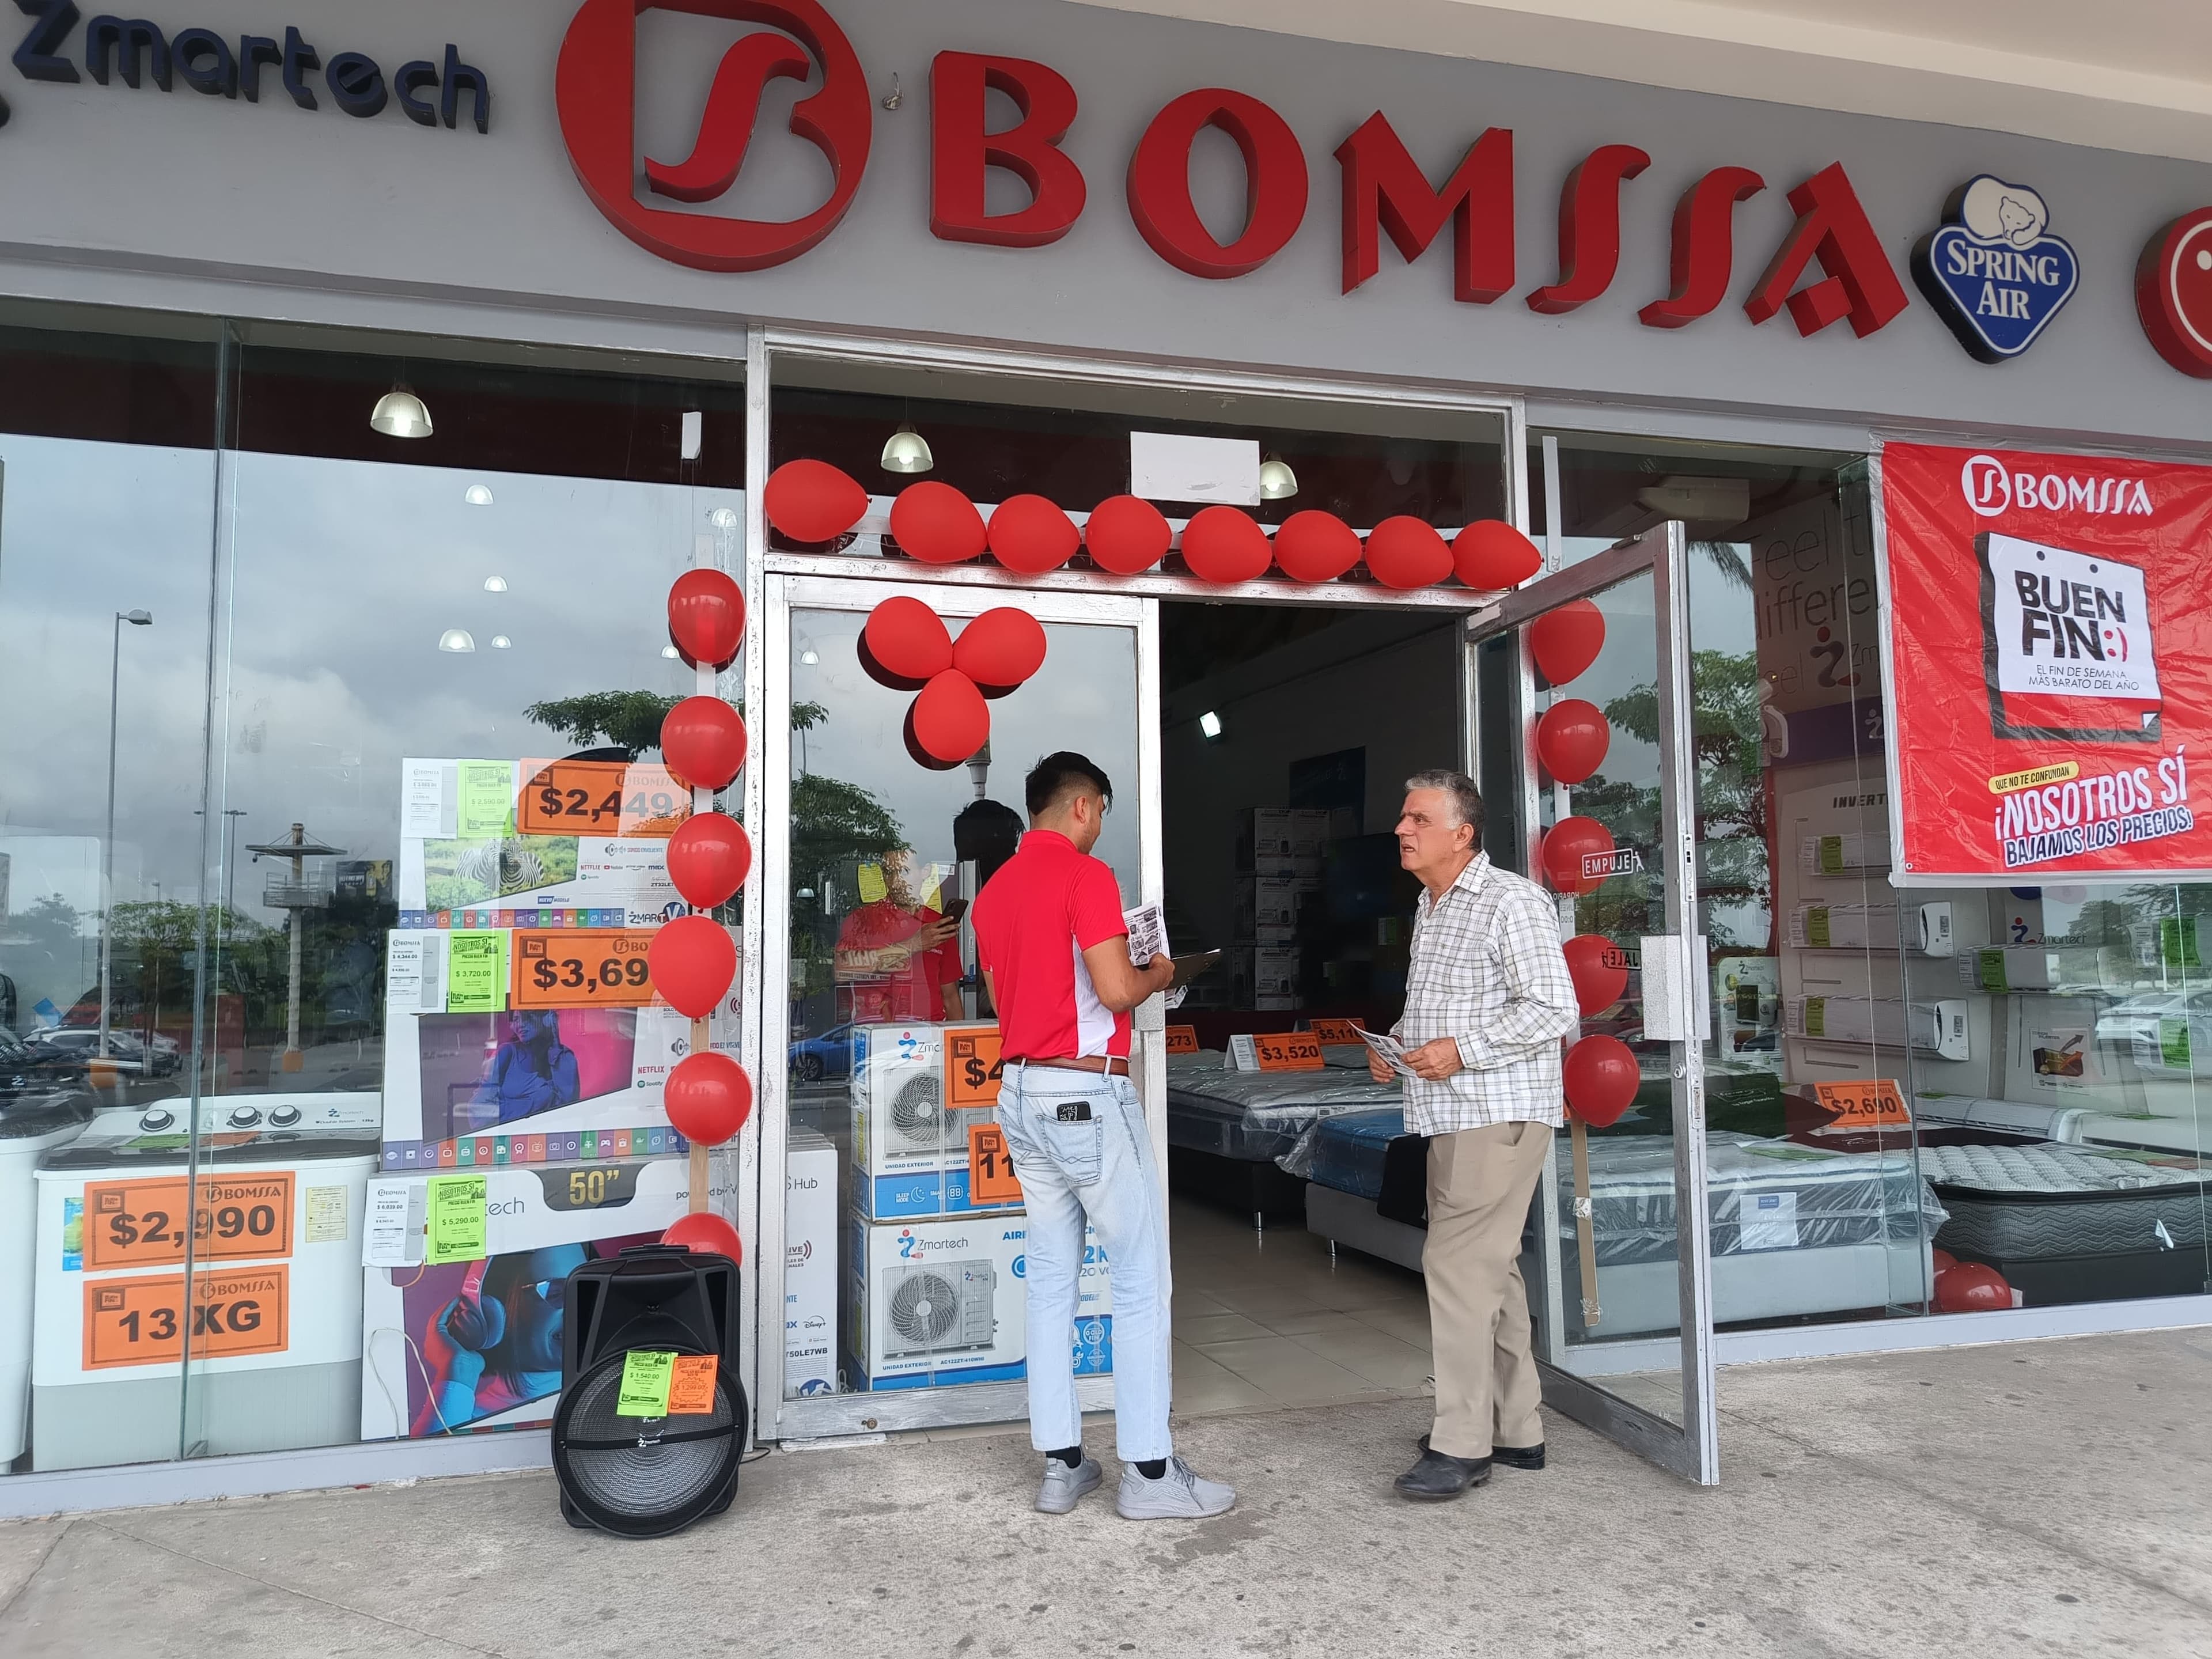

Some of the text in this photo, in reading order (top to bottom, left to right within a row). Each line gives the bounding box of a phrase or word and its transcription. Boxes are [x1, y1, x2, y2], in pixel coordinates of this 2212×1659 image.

[12, 0, 488, 134] Zmartech
[929, 50, 1910, 339] BOMSSA
[1946, 238, 2060, 286] SPRING
[1976, 281, 2031, 320] AIR
[2015, 473, 2153, 516] BOMSSA
[2014, 570, 2126, 623] BUEN
[2037, 665, 2127, 678] EL FIN DE SEMANA
[2028, 674, 2139, 691] MÁS BARATO DEL AÑO
[1995, 766, 2070, 790] QUE NO TE CONFUNDAN
[1832, 793, 1887, 809] INVERT
[1995, 744, 2188, 841] ¡NOSOTROS SÍ
[2005, 806, 2192, 865] BAJAMOS LOS PRECIOS!
[1585, 854, 1630, 874] EMPUJE
[533, 957, 649, 994] $3,69
[1167, 1035, 1192, 1047] 273
[1262, 1045, 1319, 1061] $3,520
[638, 1066, 665, 1074] NETFLIX
[965, 1057, 1006, 1089] $4
[1831, 1097, 1897, 1118] $2,690
[224, 1187, 281, 1200] BOMSSA
[794, 1177, 818, 1190] Hub
[109, 1205, 275, 1249] $2,990
[449, 1217, 479, 1225] 5,290.00
[918, 1236, 968, 1251] Zmartech
[218, 1280, 275, 1296] BOMSSA
[786, 1295, 798, 1303] NTE
[119, 1300, 261, 1342] 13 KG
[803, 1317, 827, 1329] Disney+
